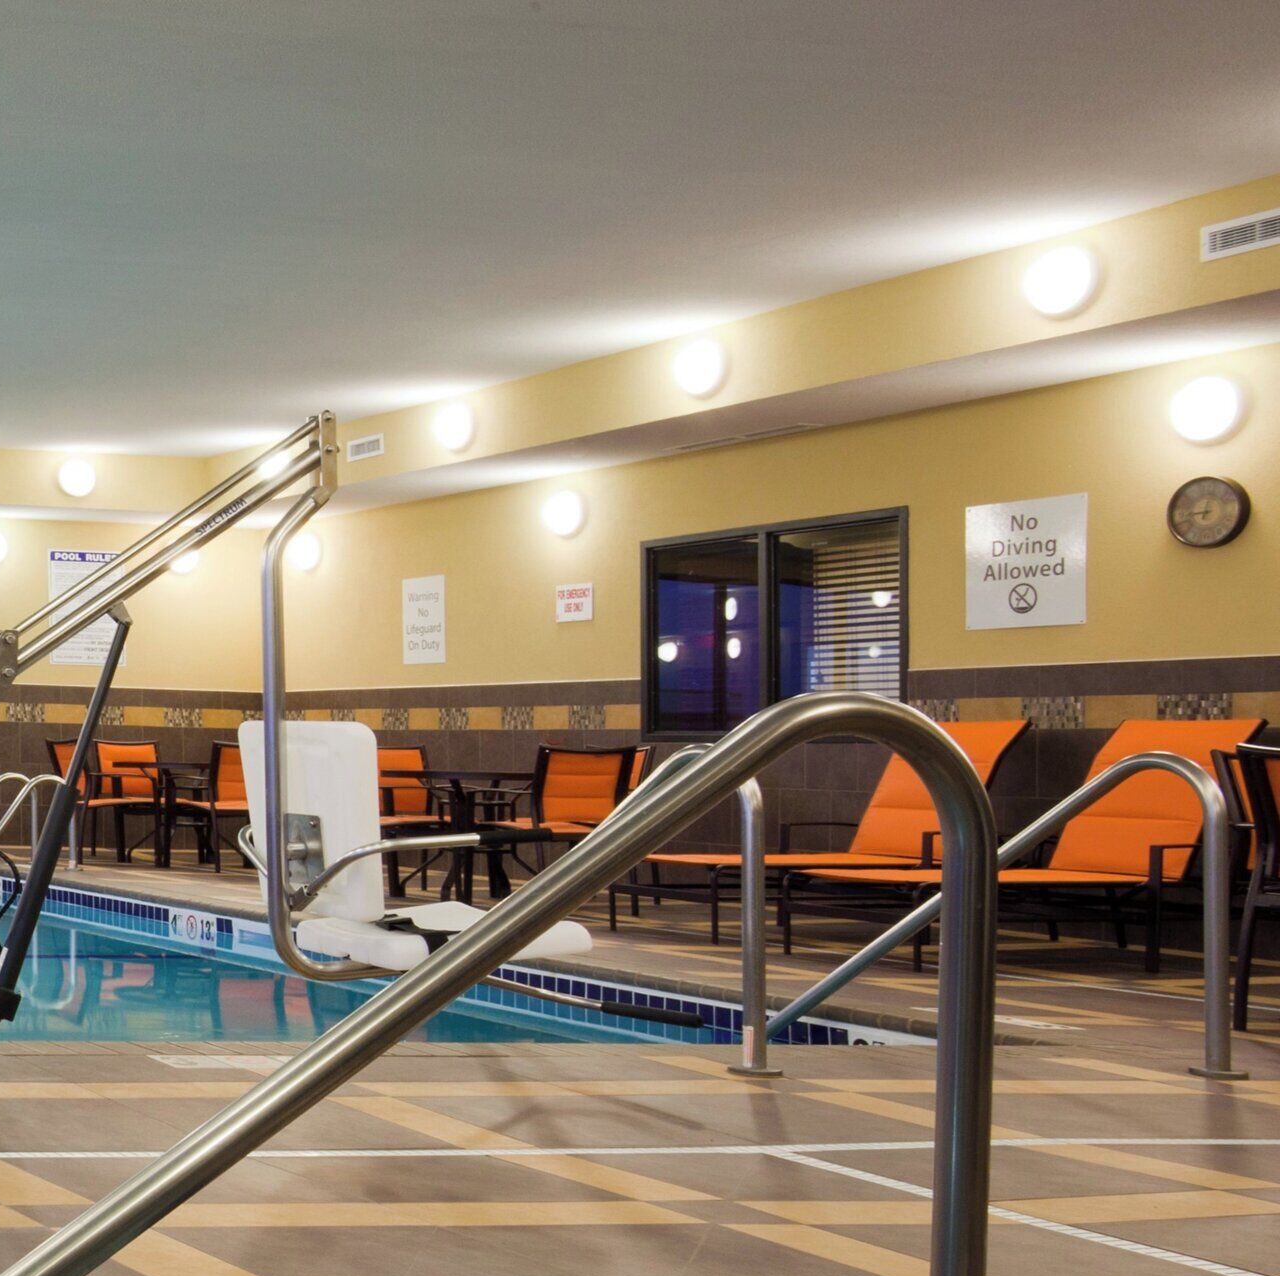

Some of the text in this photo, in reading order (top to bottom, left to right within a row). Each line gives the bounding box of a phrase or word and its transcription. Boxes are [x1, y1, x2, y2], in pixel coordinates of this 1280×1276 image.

[195, 498, 247, 536] SPECTRUM
[1010, 514, 1038, 532] No
[992, 537, 1057, 557] Diving
[54, 552, 82, 561] POOL
[983, 557, 1065, 582] Allowed
[408, 592, 439, 602] Warning
[566, 588, 590, 599] EMERGENCY
[418, 608, 429, 617] No
[564, 602, 584, 612] USE ONLY
[407, 622, 441, 636] Lifeguard
[408, 640, 439, 651] On Duty
